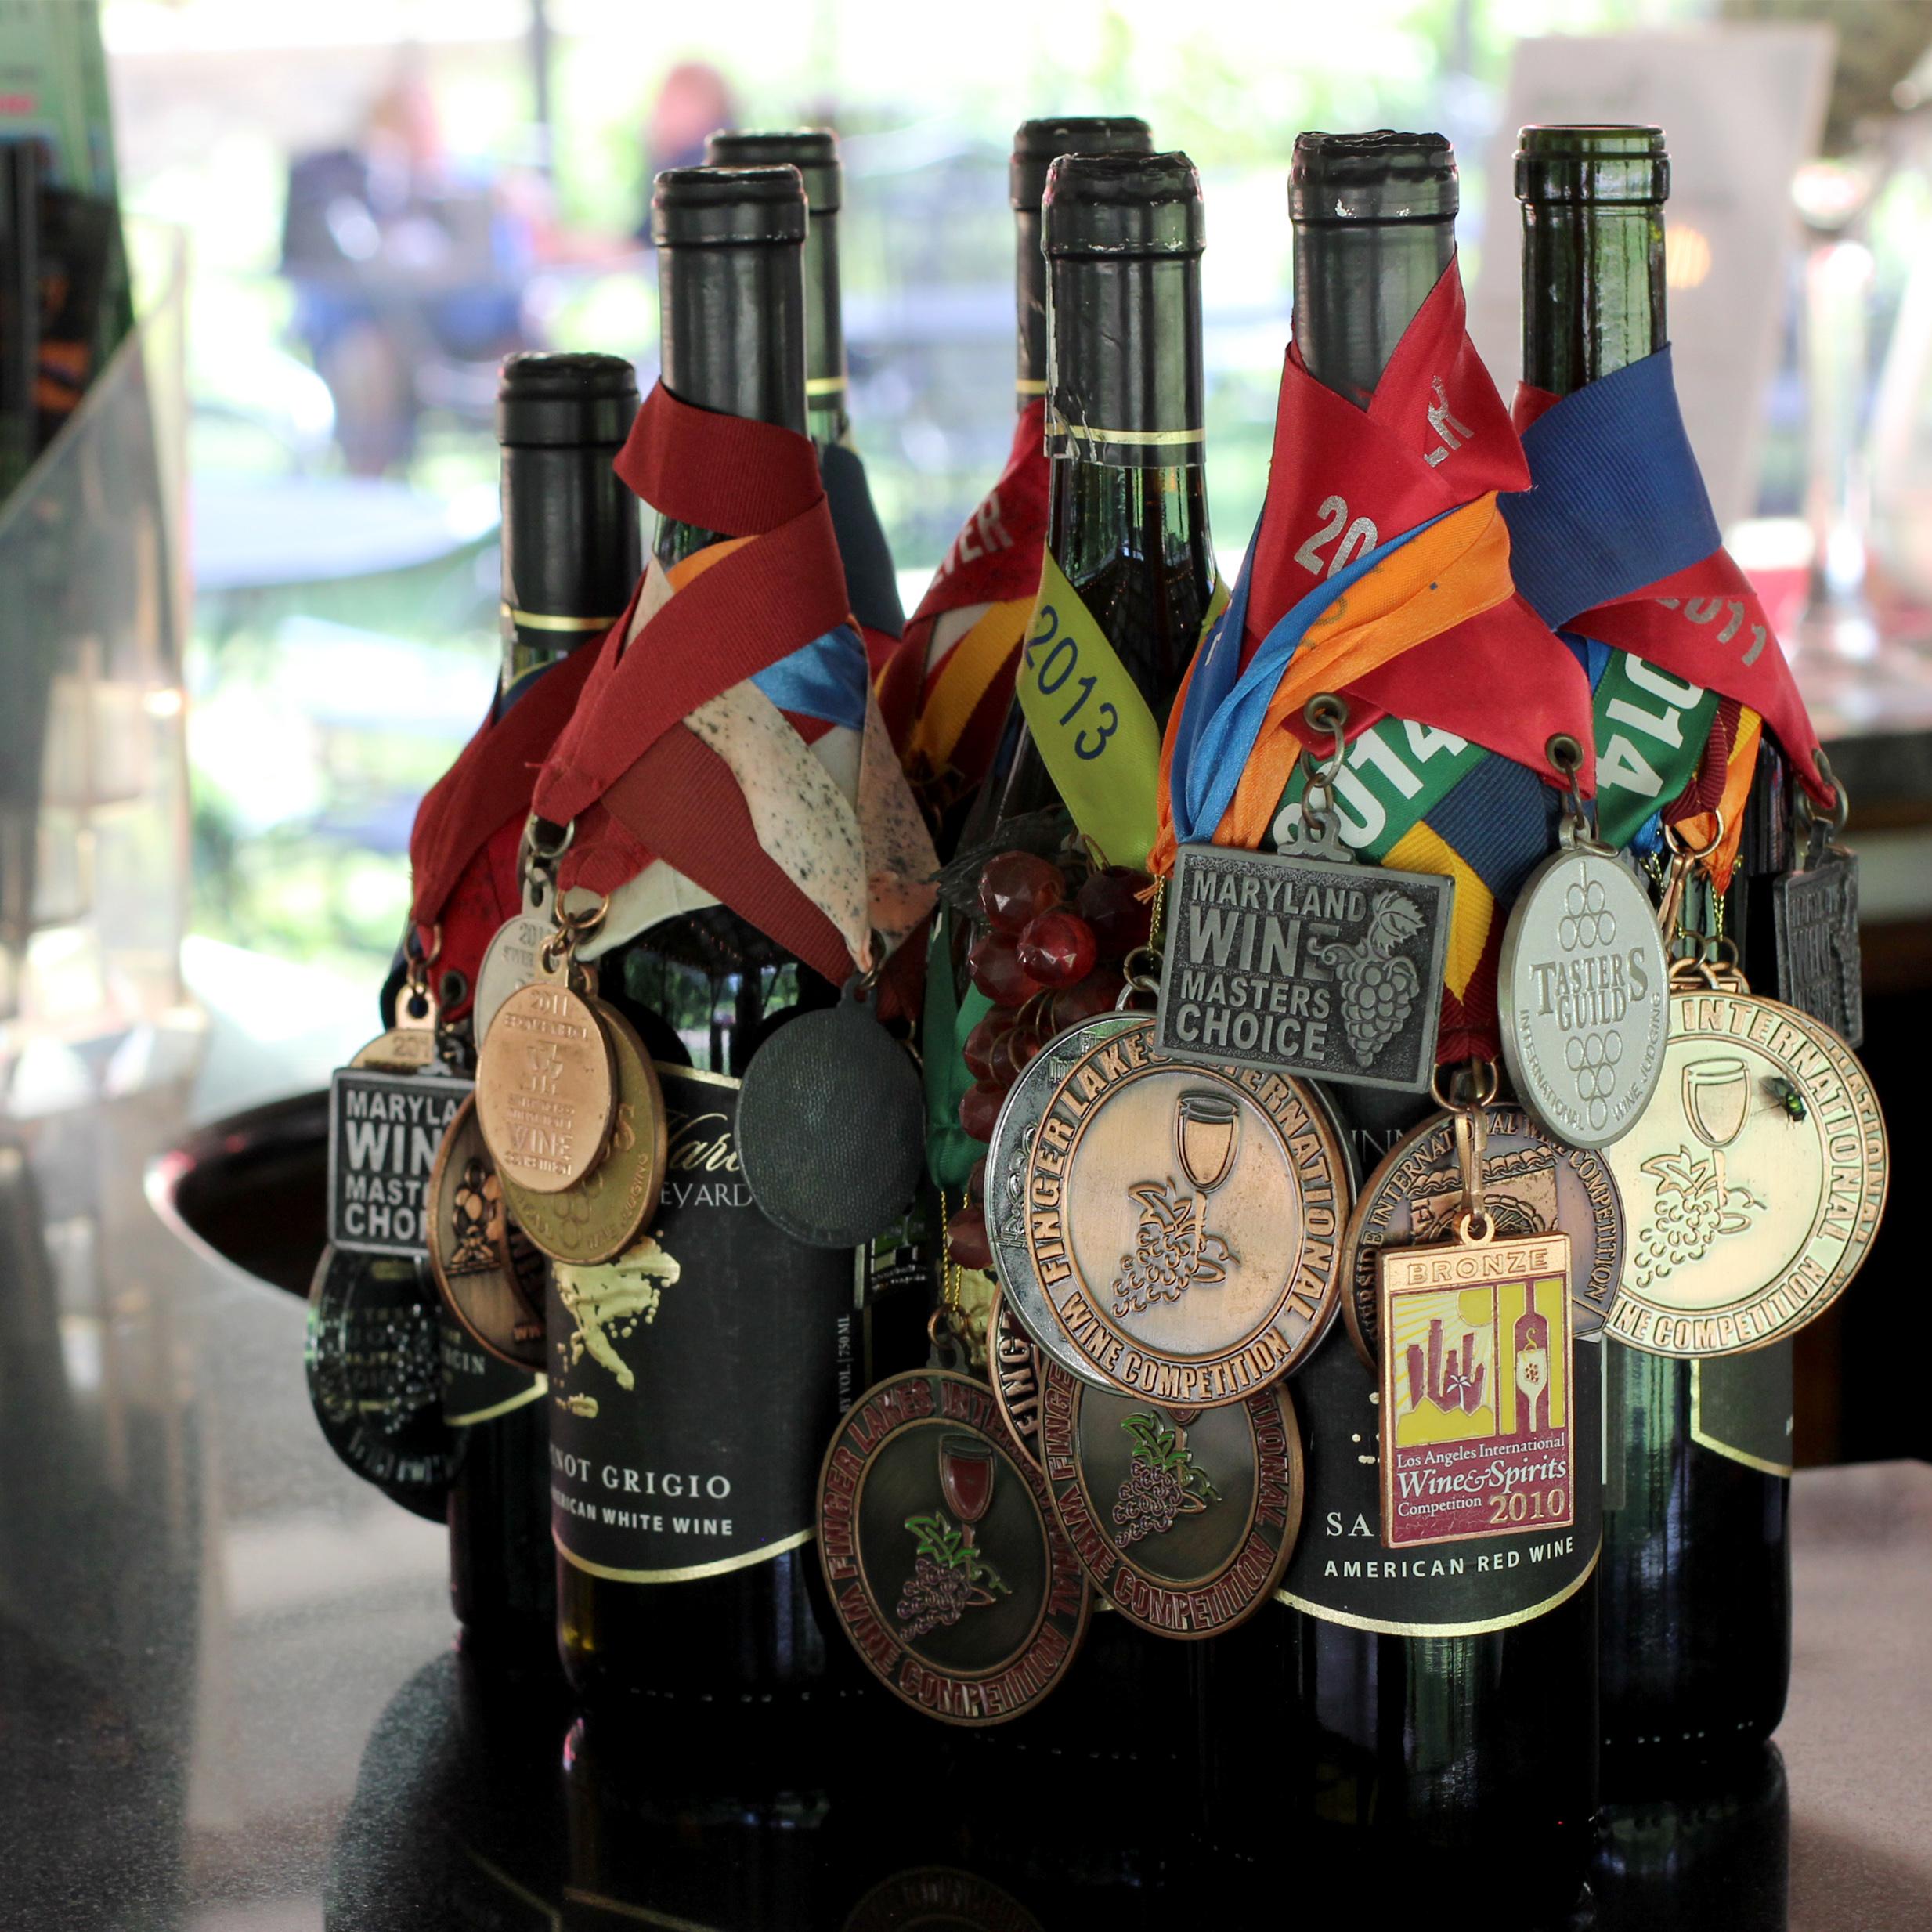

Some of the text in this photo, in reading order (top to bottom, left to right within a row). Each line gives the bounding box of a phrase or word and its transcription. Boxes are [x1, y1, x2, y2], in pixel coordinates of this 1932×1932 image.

[1024, 605, 1118, 760] 2013
[1192, 869, 1367, 923] MARYLAND
[1190, 905, 1341, 982] WINE
[1179, 970, 1330, 1020] MASTERS
[1529, 947, 1649, 1017] TASTERS
[1555, 988, 1627, 1031] GUILD
[1176, 1003, 1329, 1062] CHOICE
[1519, 991, 1662, 1131] INTERNATIONAL WINE JUDGING
[345, 1089, 459, 1125] MARYLA
[1681, 998, 1863, 1242] INTERNATIONAL
[345, 1120, 444, 1175] WIN
[345, 1174, 430, 1208] MAST
[1569, 1149, 1616, 1303] COMPETITION
[1031, 1118, 1075, 1285] FINGER
[1060, 1291, 1125, 1371] WINE
[1121, 1326, 1291, 1400] COMPETITION
[1407, 1248, 1549, 1286] BRONZE
[1653, 1255, 1829, 1350] COMPETITION
[848, 1378, 933, 1454] LAKES
[1045, 1361, 1078, 1481] FINGE
[601, 1464, 731, 1499] GRIGIO
[1397, 1435, 1565, 1469] Los Angeles International
[602, 1507, 664, 1532] WHITE
[673, 1516, 734, 1537] WINE
[823, 1446, 865, 1580] FINGER
[1058, 1484, 1118, 1583] WINE
[1326, 1511, 1374, 1537] SA
[1397, 1487, 1566, 1524] Competition 2010
[1114, 1531, 1278, 1630] COMPETITION
[1324, 1536, 1574, 1579] AMERICAN RED WINE
[839, 1582, 902, 1676] WINE
[900, 1620, 1071, 1717] COMPETITION
